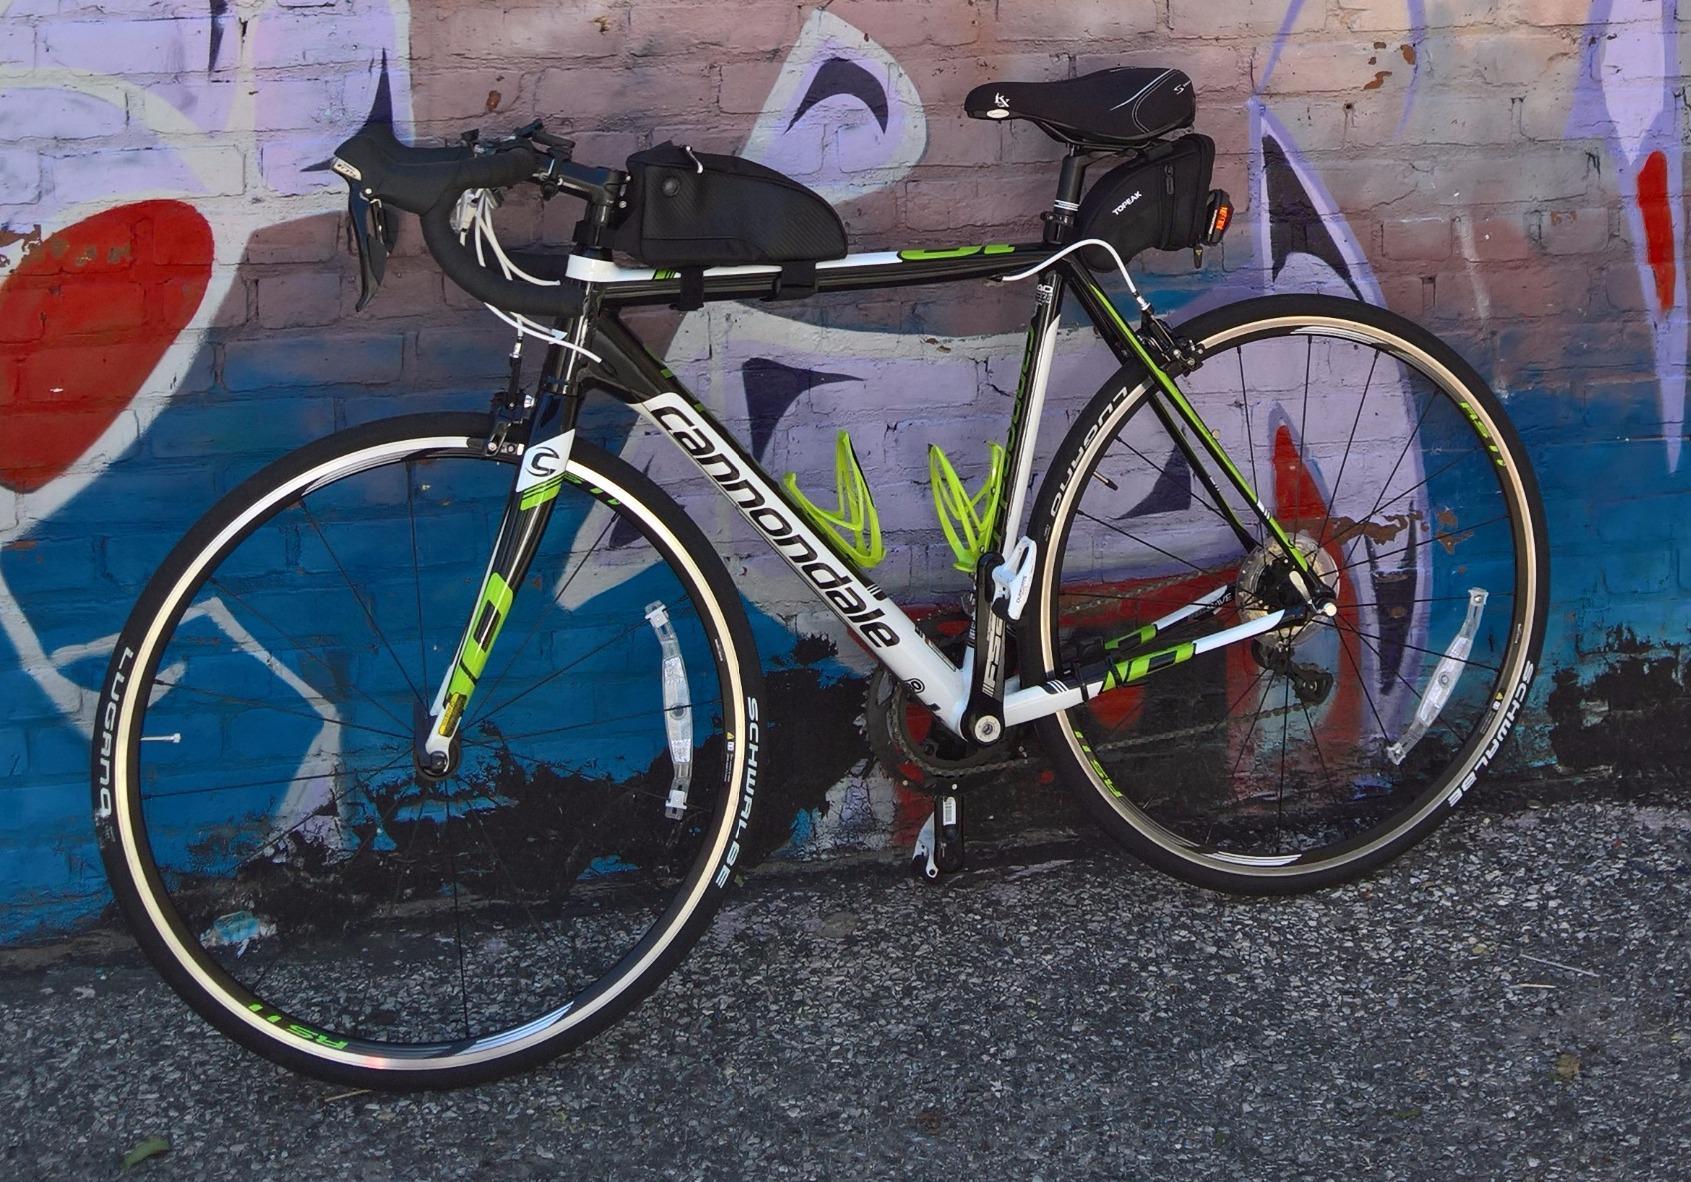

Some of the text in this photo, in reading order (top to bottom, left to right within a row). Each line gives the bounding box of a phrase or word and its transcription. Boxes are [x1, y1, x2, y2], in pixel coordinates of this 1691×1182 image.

[1111, 190, 1143, 216] TOPEAK
[650, 406, 901, 648] cannondale
[715, 696, 760, 889] SCHWALBE
[1447, 659, 1536, 808] SCHWALBE
